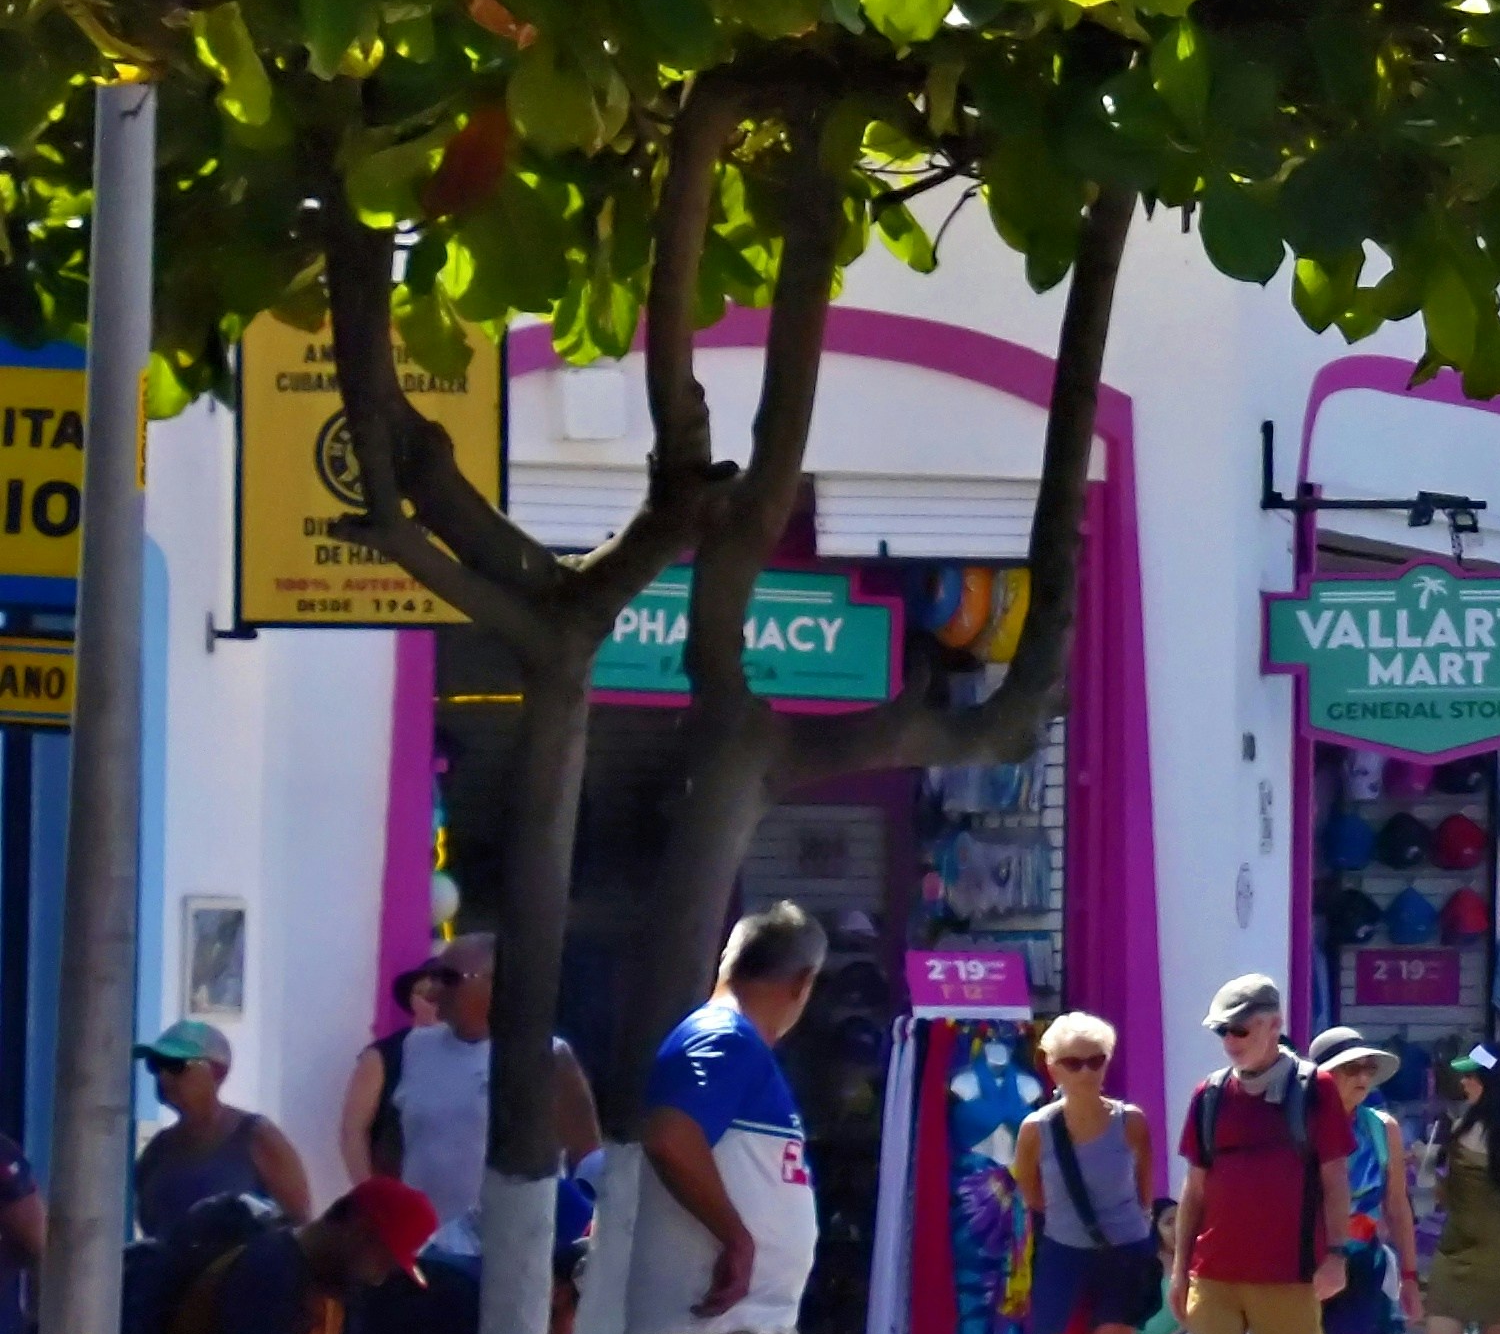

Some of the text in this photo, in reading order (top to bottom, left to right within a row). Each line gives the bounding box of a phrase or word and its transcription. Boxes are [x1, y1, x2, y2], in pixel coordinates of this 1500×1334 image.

[373, 598, 434, 613] 1942
[1368, 652, 1491, 686] MART
[1327, 701, 1438, 720] GENERAL
